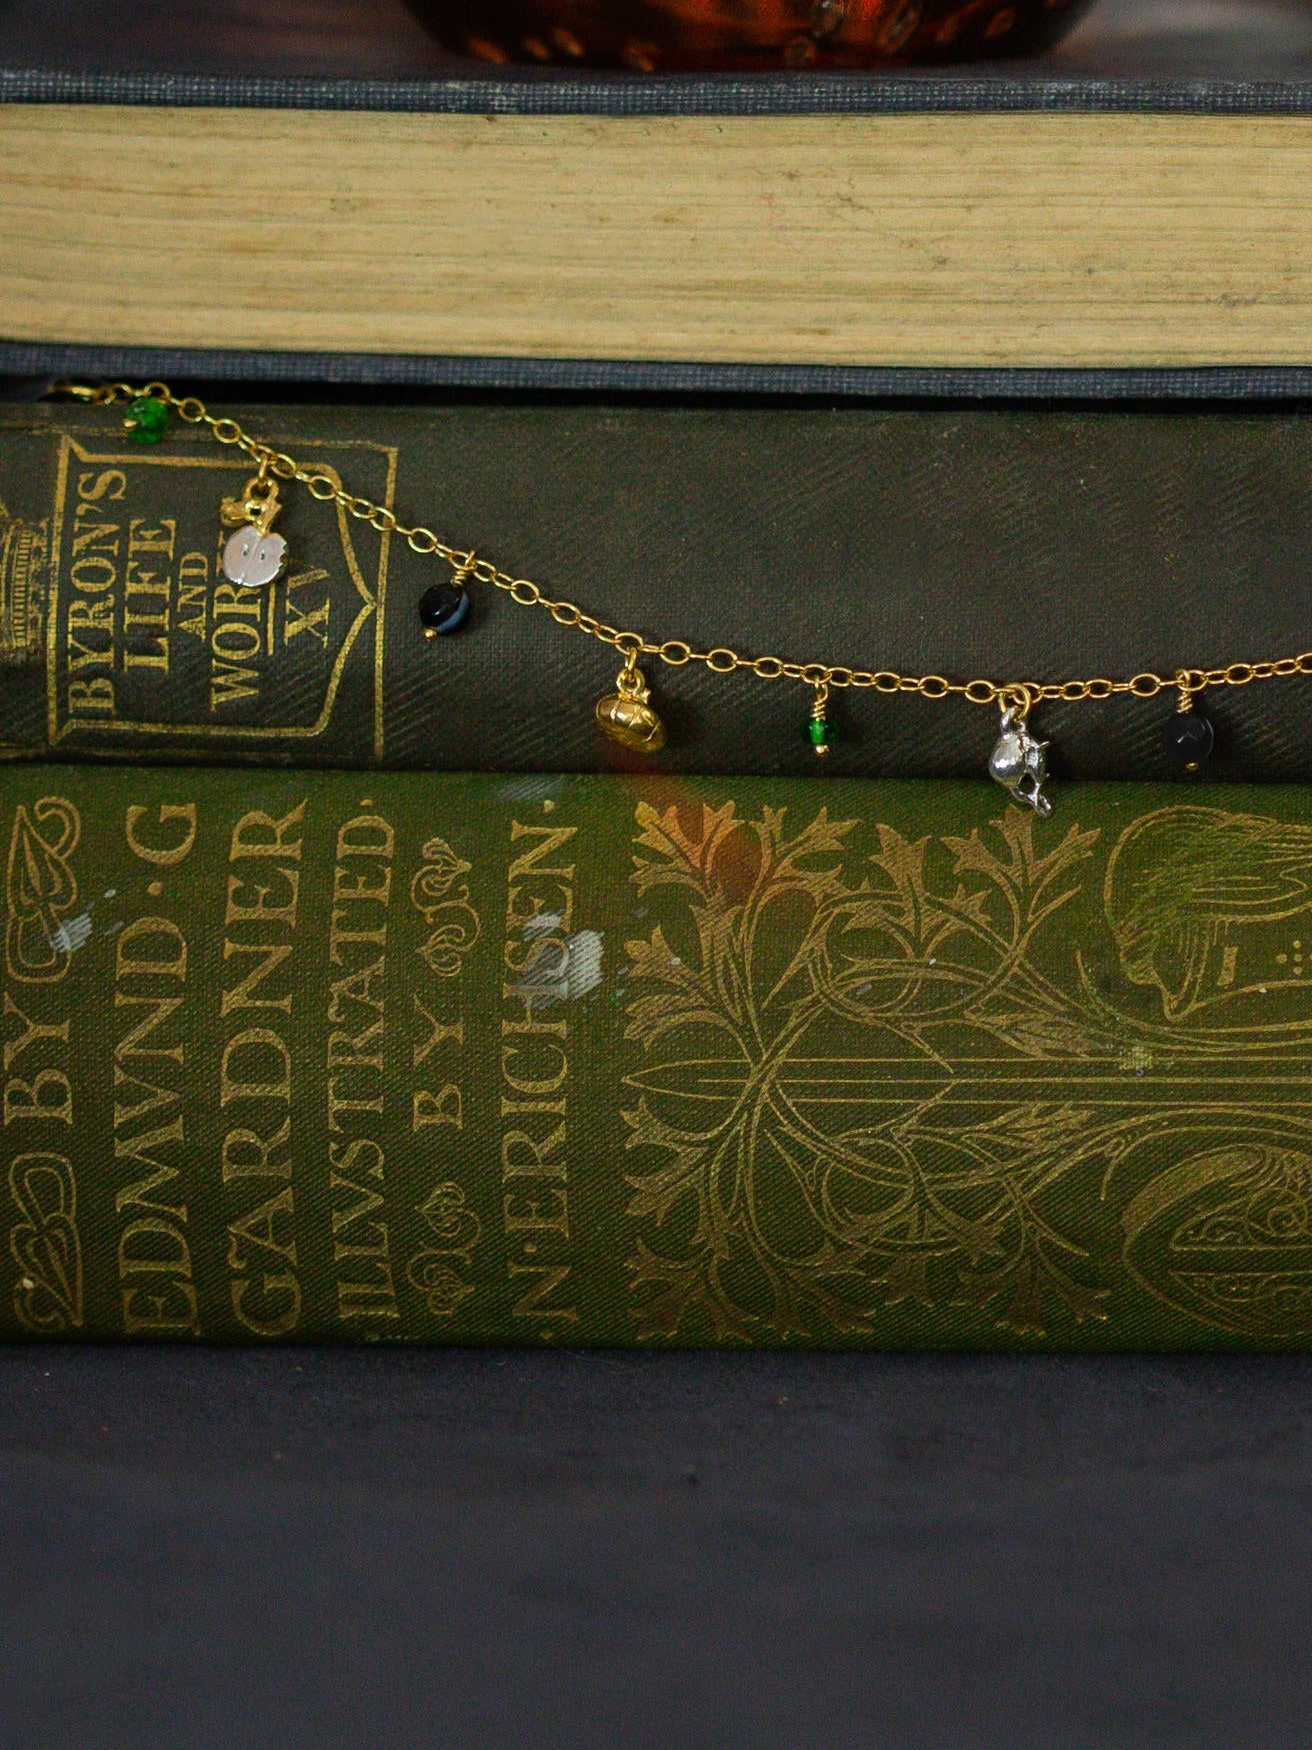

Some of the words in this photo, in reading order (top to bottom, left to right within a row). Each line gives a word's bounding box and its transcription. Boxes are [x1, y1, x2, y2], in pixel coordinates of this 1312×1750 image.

[68, 469, 127, 714] BYRON'S
[123, 518, 176, 674] LIFE
[177, 552, 208, 642] AND
[209, 500, 261, 713] WOR
[3, 992, 73, 1125] BY
[220, 800, 308, 1336] GARDNER
[327, 814, 399, 1320] ILLVSTRATED
[412, 994, 464, 1133] BY
